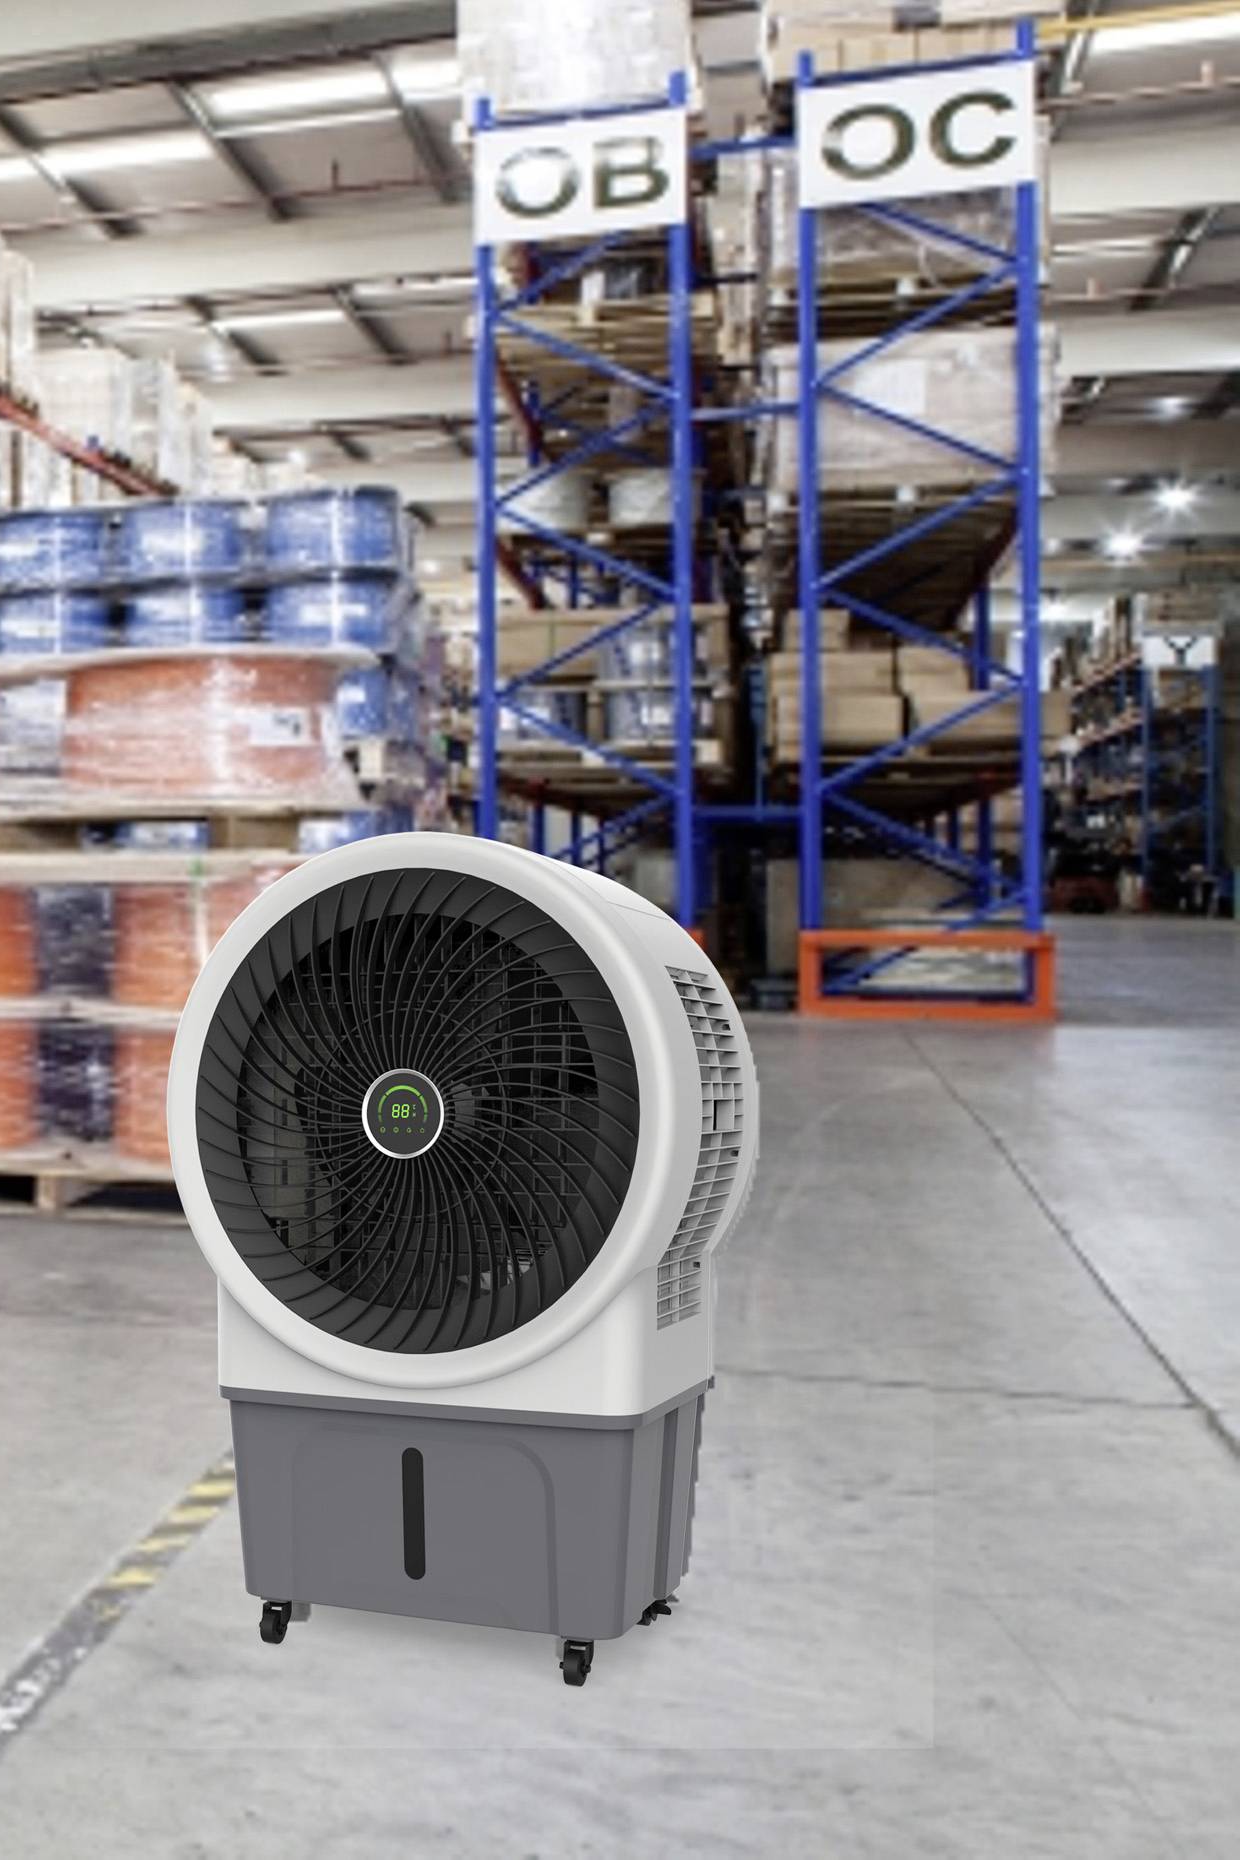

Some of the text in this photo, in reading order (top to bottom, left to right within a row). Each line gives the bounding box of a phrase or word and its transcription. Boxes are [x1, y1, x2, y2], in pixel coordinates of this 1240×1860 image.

[821, 91, 1016, 180] OC
[496, 136, 669, 218] OB
[1162, 636, 1198, 668] Y
[391, 1104, 410, 1118] 88
